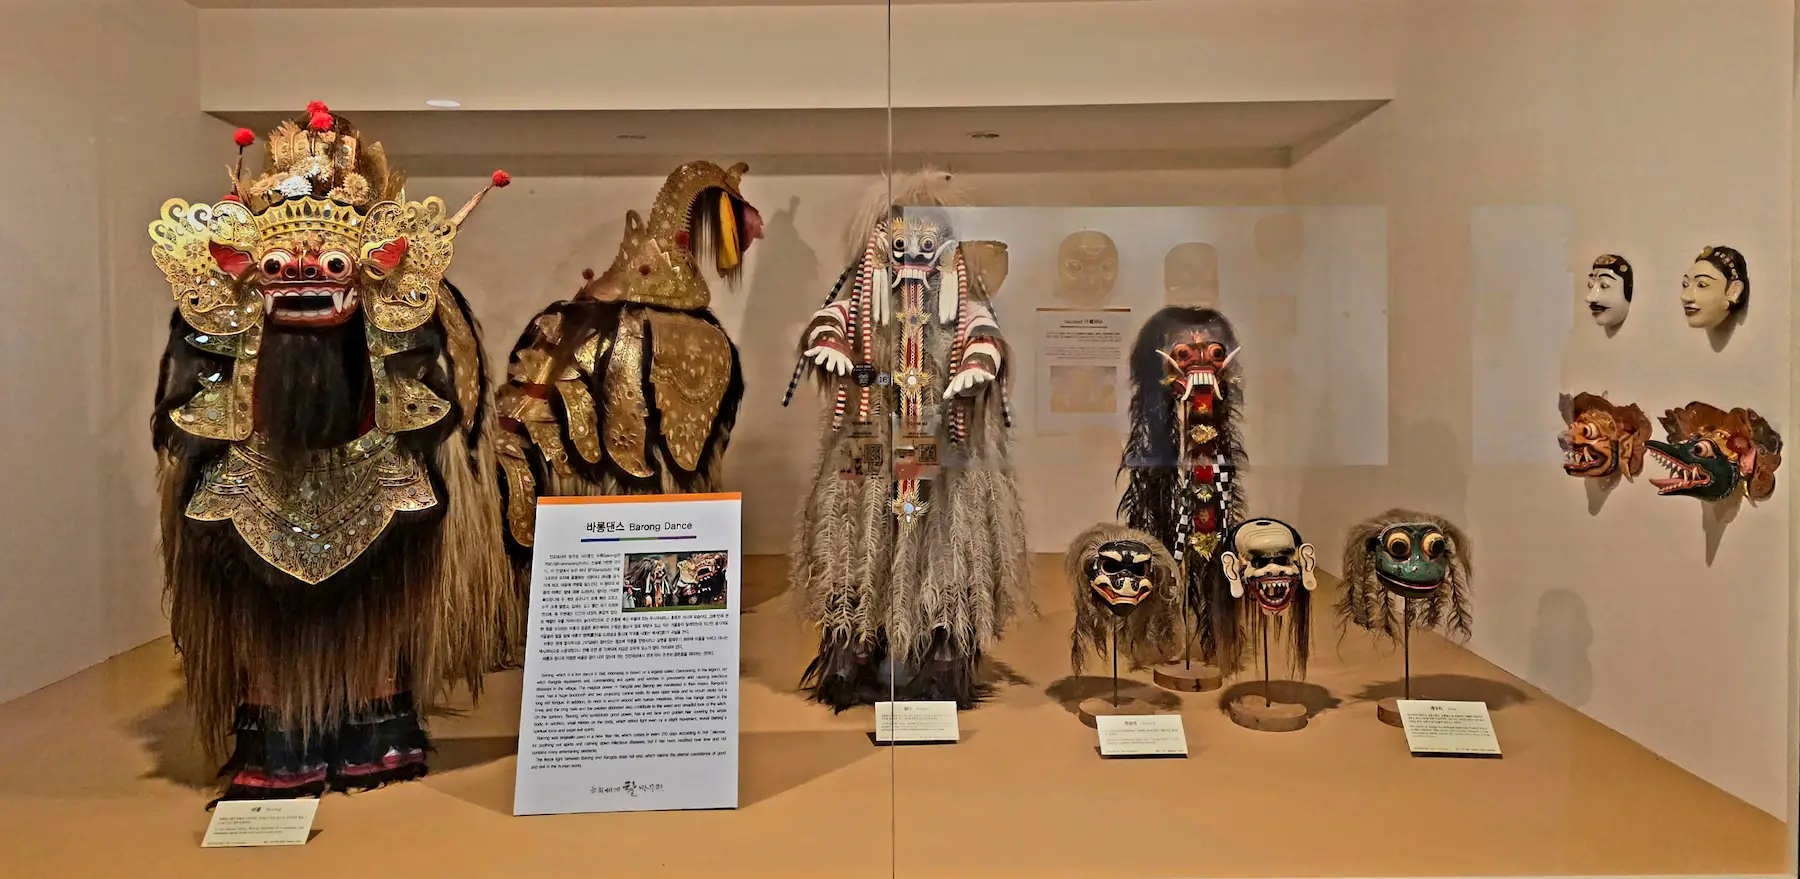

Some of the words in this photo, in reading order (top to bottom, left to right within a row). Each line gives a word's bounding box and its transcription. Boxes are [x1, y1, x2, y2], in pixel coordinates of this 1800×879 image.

[586, 521, 625, 533] 바롱댄스
[629, 523, 660, 532] Barong
[664, 521, 692, 530] Dance
